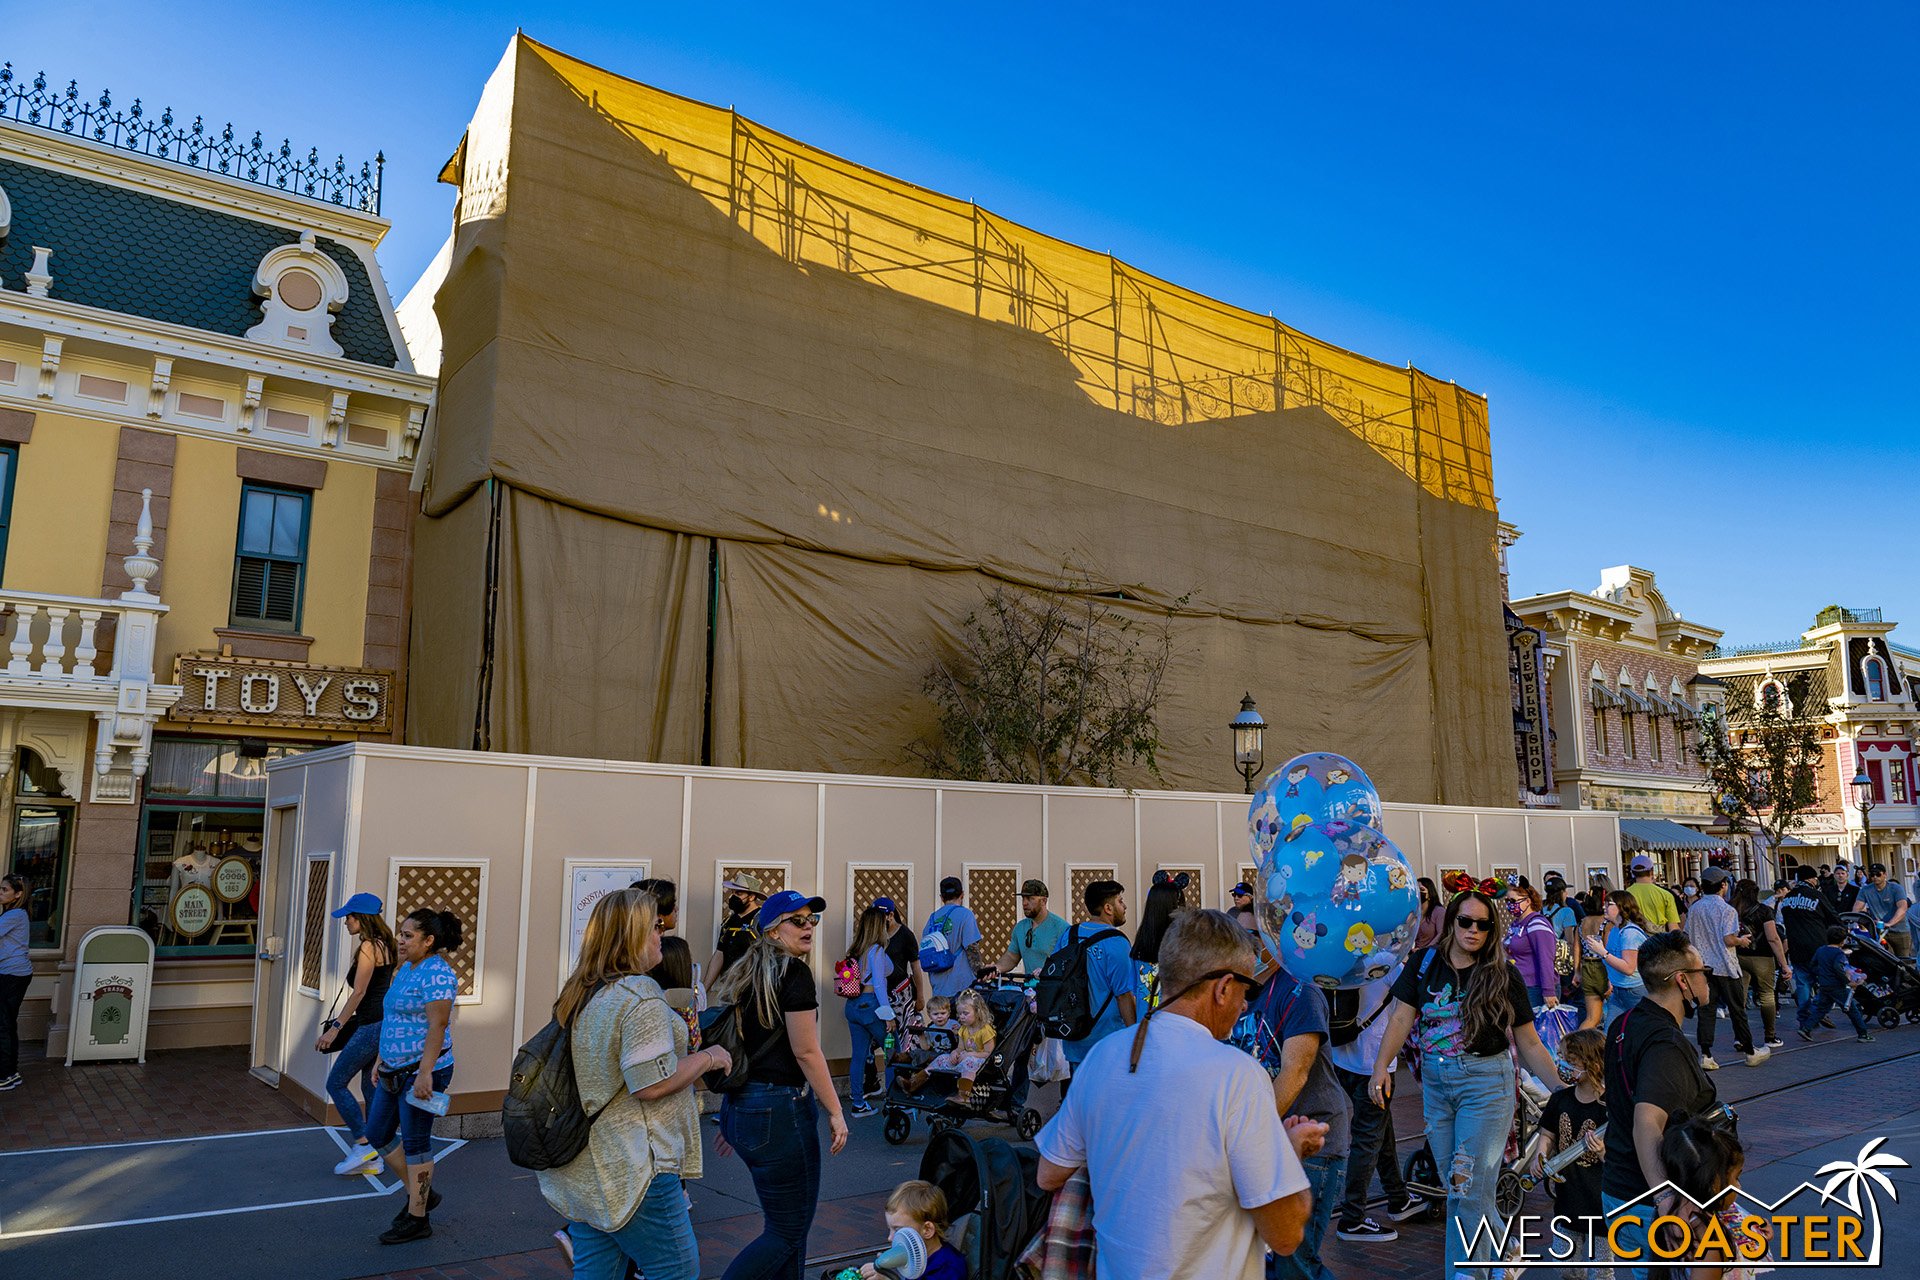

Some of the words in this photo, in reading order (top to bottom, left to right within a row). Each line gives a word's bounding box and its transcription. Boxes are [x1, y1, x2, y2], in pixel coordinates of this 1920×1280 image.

[193, 667, 379, 720] TOYS
[1522, 650, 1537, 733] JEWELRY
[1529, 734, 1541, 779] SHOP
[220, 873, 246, 881] GOODS
[184, 900, 203, 908] MAIN
[577, 889, 608, 912] CRYSTAL
[179, 908, 208, 918] STREET
